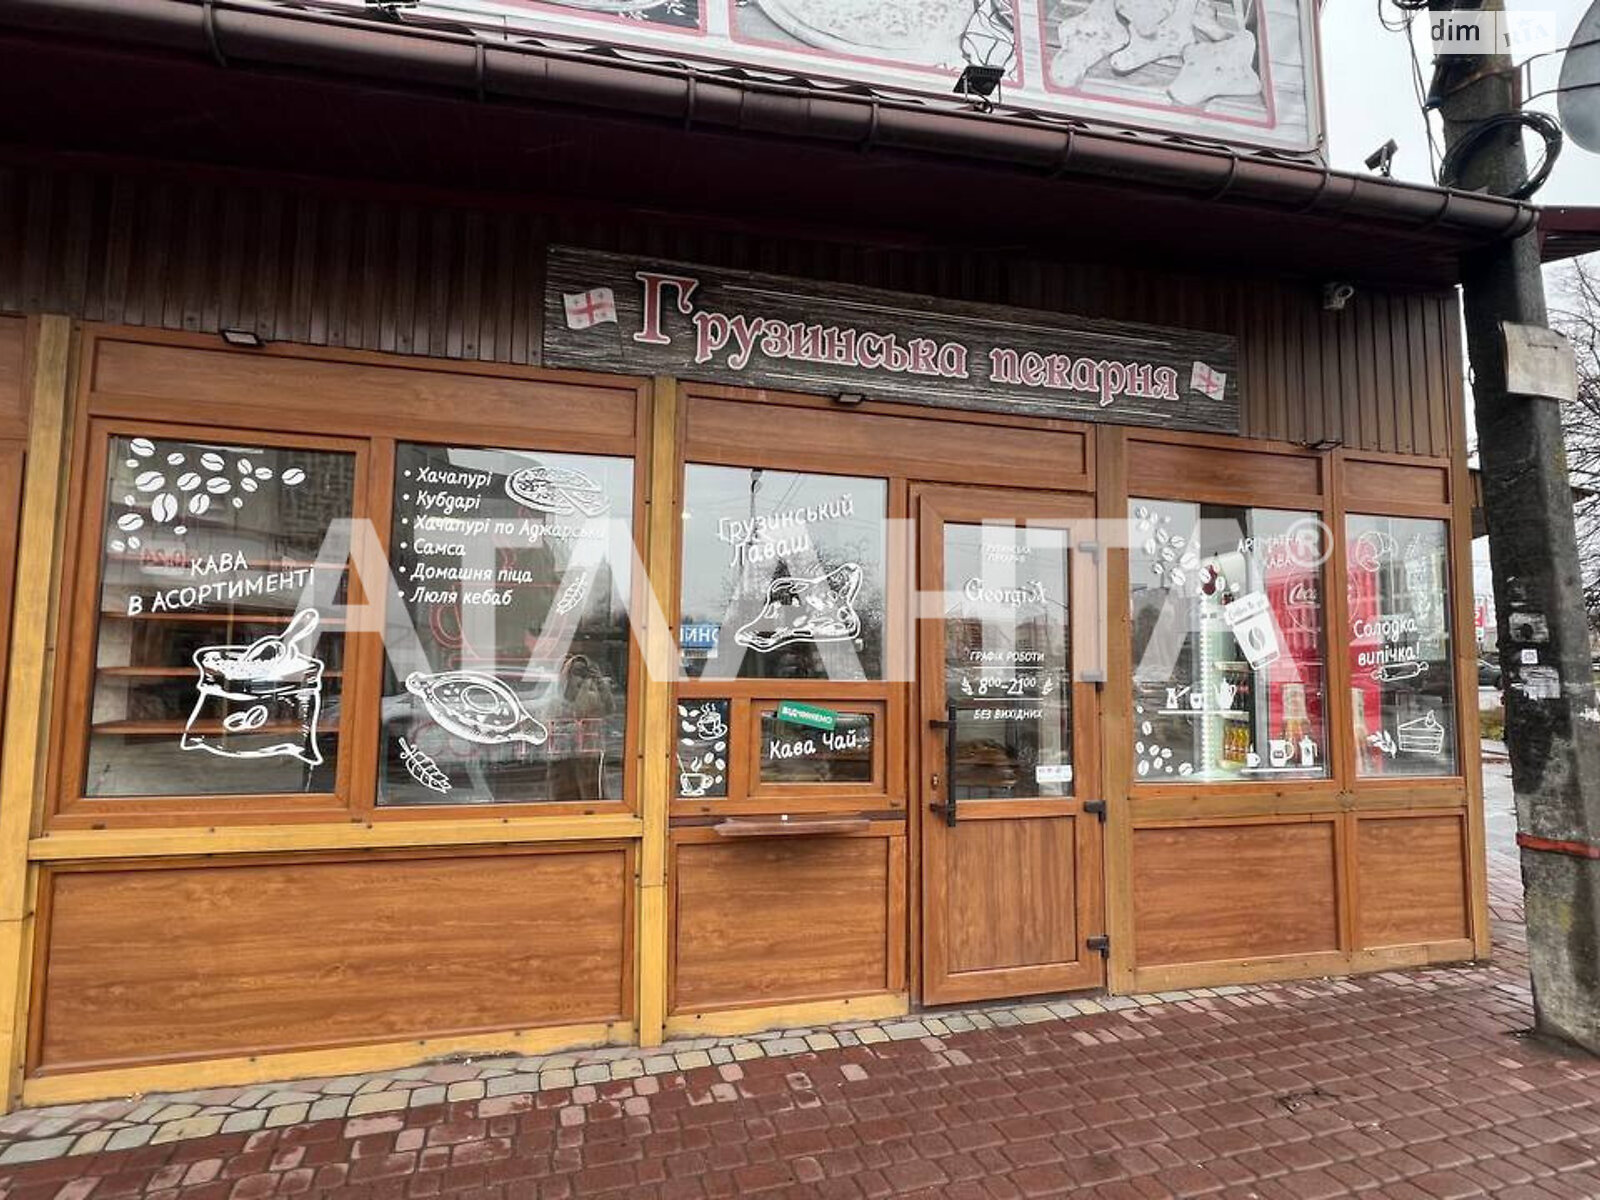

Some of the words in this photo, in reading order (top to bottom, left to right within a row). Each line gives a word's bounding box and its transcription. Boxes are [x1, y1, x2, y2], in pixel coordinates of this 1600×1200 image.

[634, 271, 970, 379] Грузинська
[988, 347, 1179, 406] пекарня
[415, 466, 492, 486] Хачапурі
[415, 490, 481, 514] Кубдарі
[413, 514, 490, 534] Хачапурі
[494, 521, 515, 534] по
[716, 493, 856, 544] Грузинський
[412, 538, 466, 556] Самса
[729, 534, 811, 567] Лаваш
[190, 550, 248, 577] КАВА
[409, 564, 493, 581] Домашня
[498, 567, 533, 583] піца
[127, 595, 143, 617] В
[151, 564, 316, 613] АСОРТИМЕНТІ
[409, 586, 457, 604] Люля
[462, 588, 513, 606] кебаб
[1352, 617, 1418, 642] Солодка
[1357, 641, 1420, 667] випічка!
[769, 740, 816, 760] Кава
